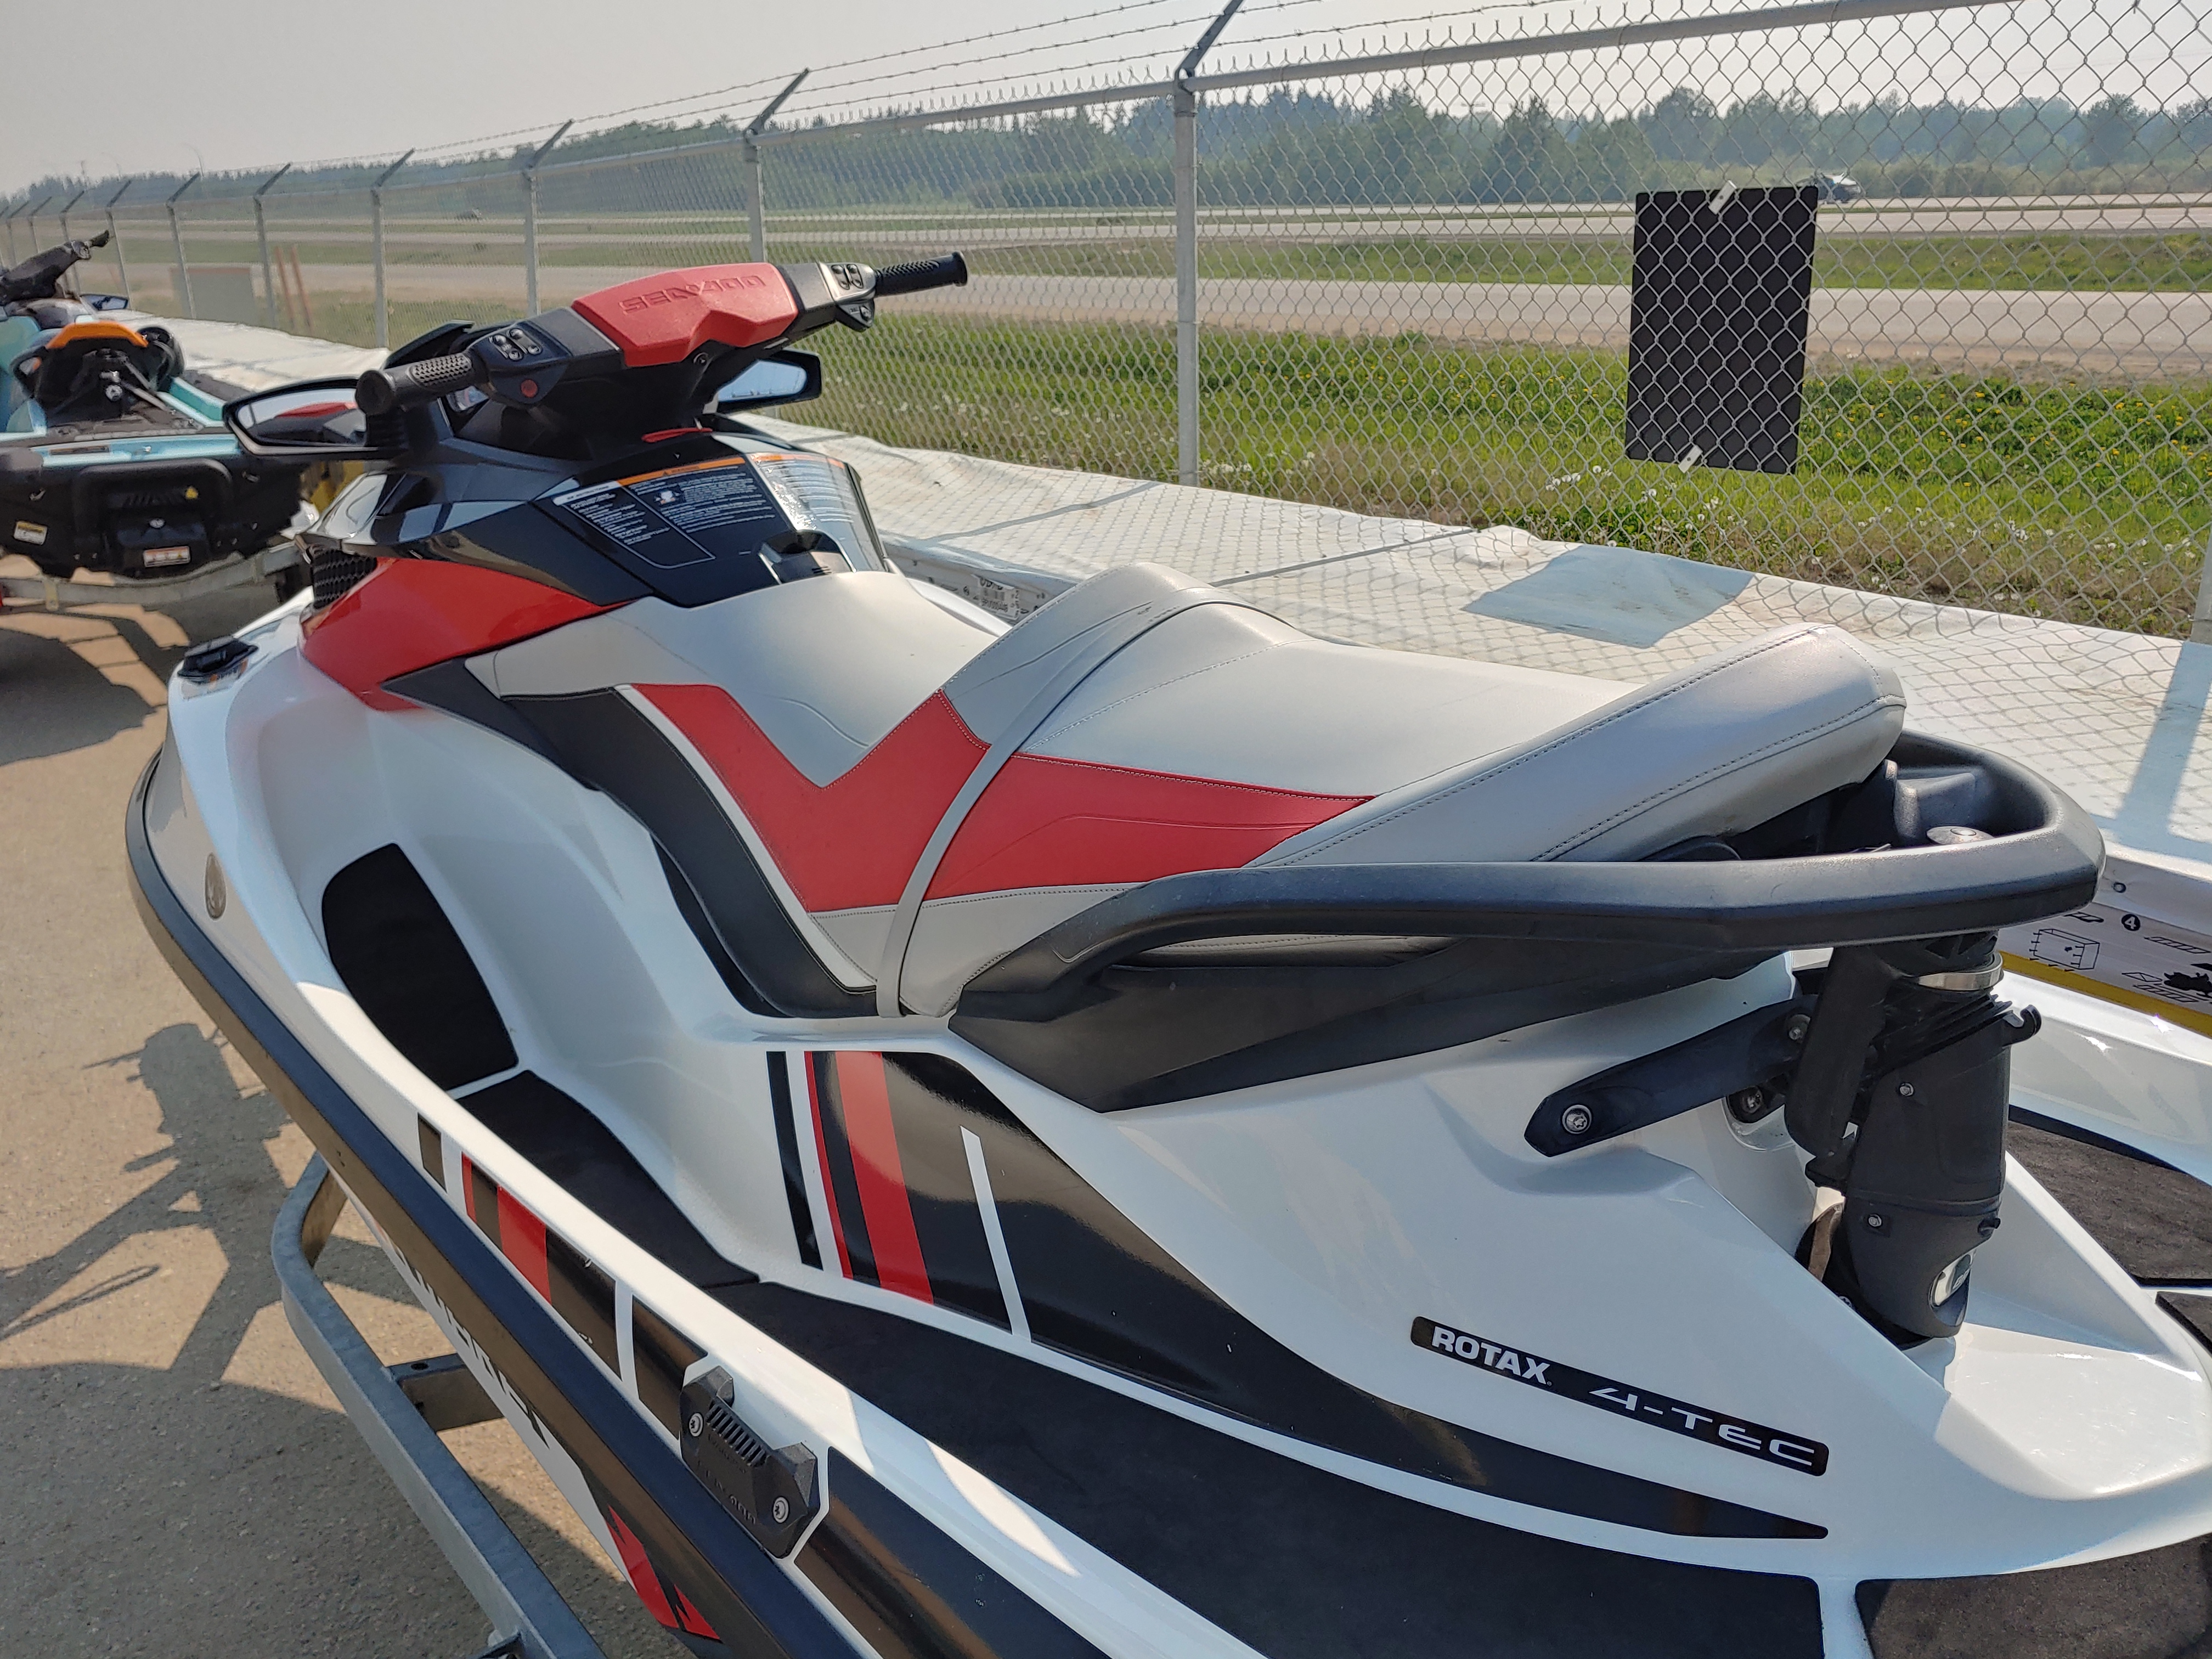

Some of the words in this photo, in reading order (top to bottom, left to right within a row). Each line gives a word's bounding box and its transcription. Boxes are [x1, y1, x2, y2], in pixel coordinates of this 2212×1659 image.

[2123, 915, 2138, 930] 4
[1431, 1326, 1551, 1385] ROTAX
[1589, 1387, 1815, 1466] 4-TEC
